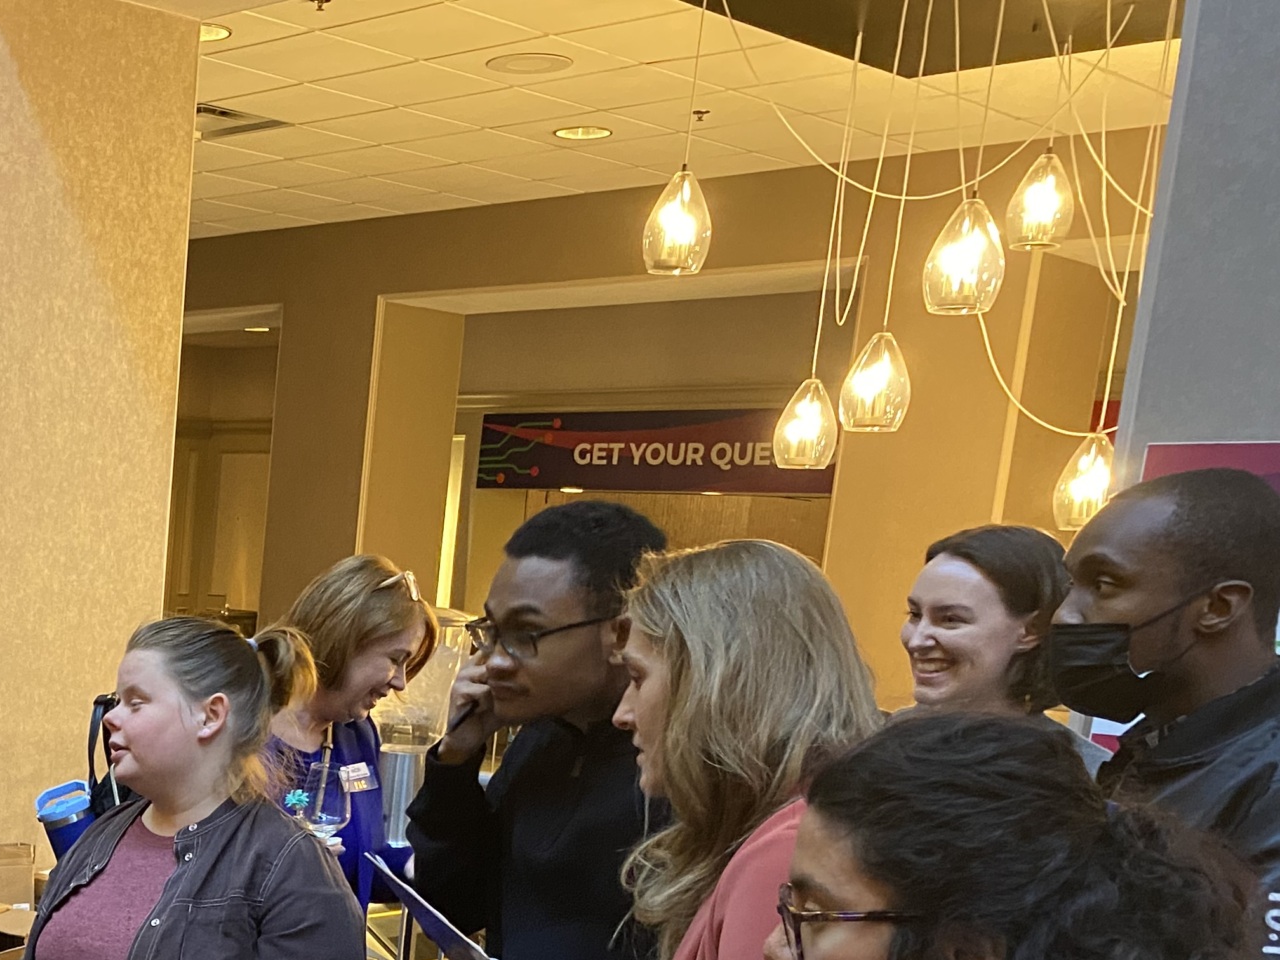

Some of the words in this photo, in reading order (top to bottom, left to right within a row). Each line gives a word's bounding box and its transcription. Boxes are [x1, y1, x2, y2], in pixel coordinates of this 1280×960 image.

[574, 442, 625, 465] GET
[629, 442, 704, 466] YOUR
[710, 442, 773, 471] QUE
